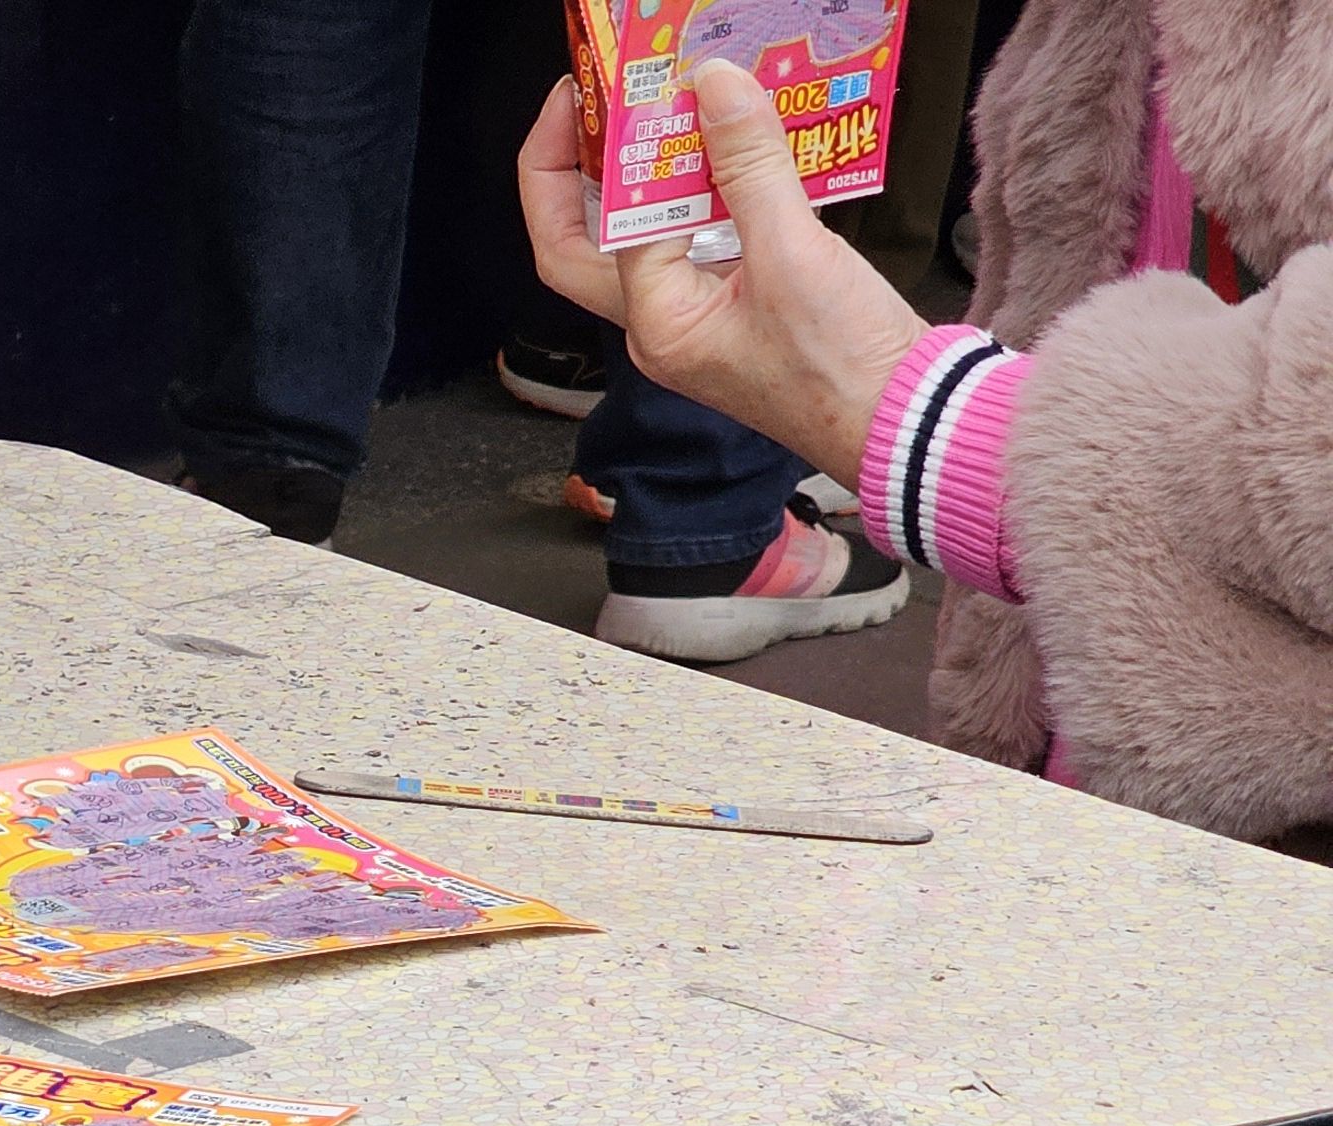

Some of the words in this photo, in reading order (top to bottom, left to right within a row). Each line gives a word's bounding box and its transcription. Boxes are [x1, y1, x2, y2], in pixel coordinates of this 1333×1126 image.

[765, 71, 871, 118] 頭獎200
[786, 104, 880, 177] 祈福
[827, 167, 880, 191] NT$200
